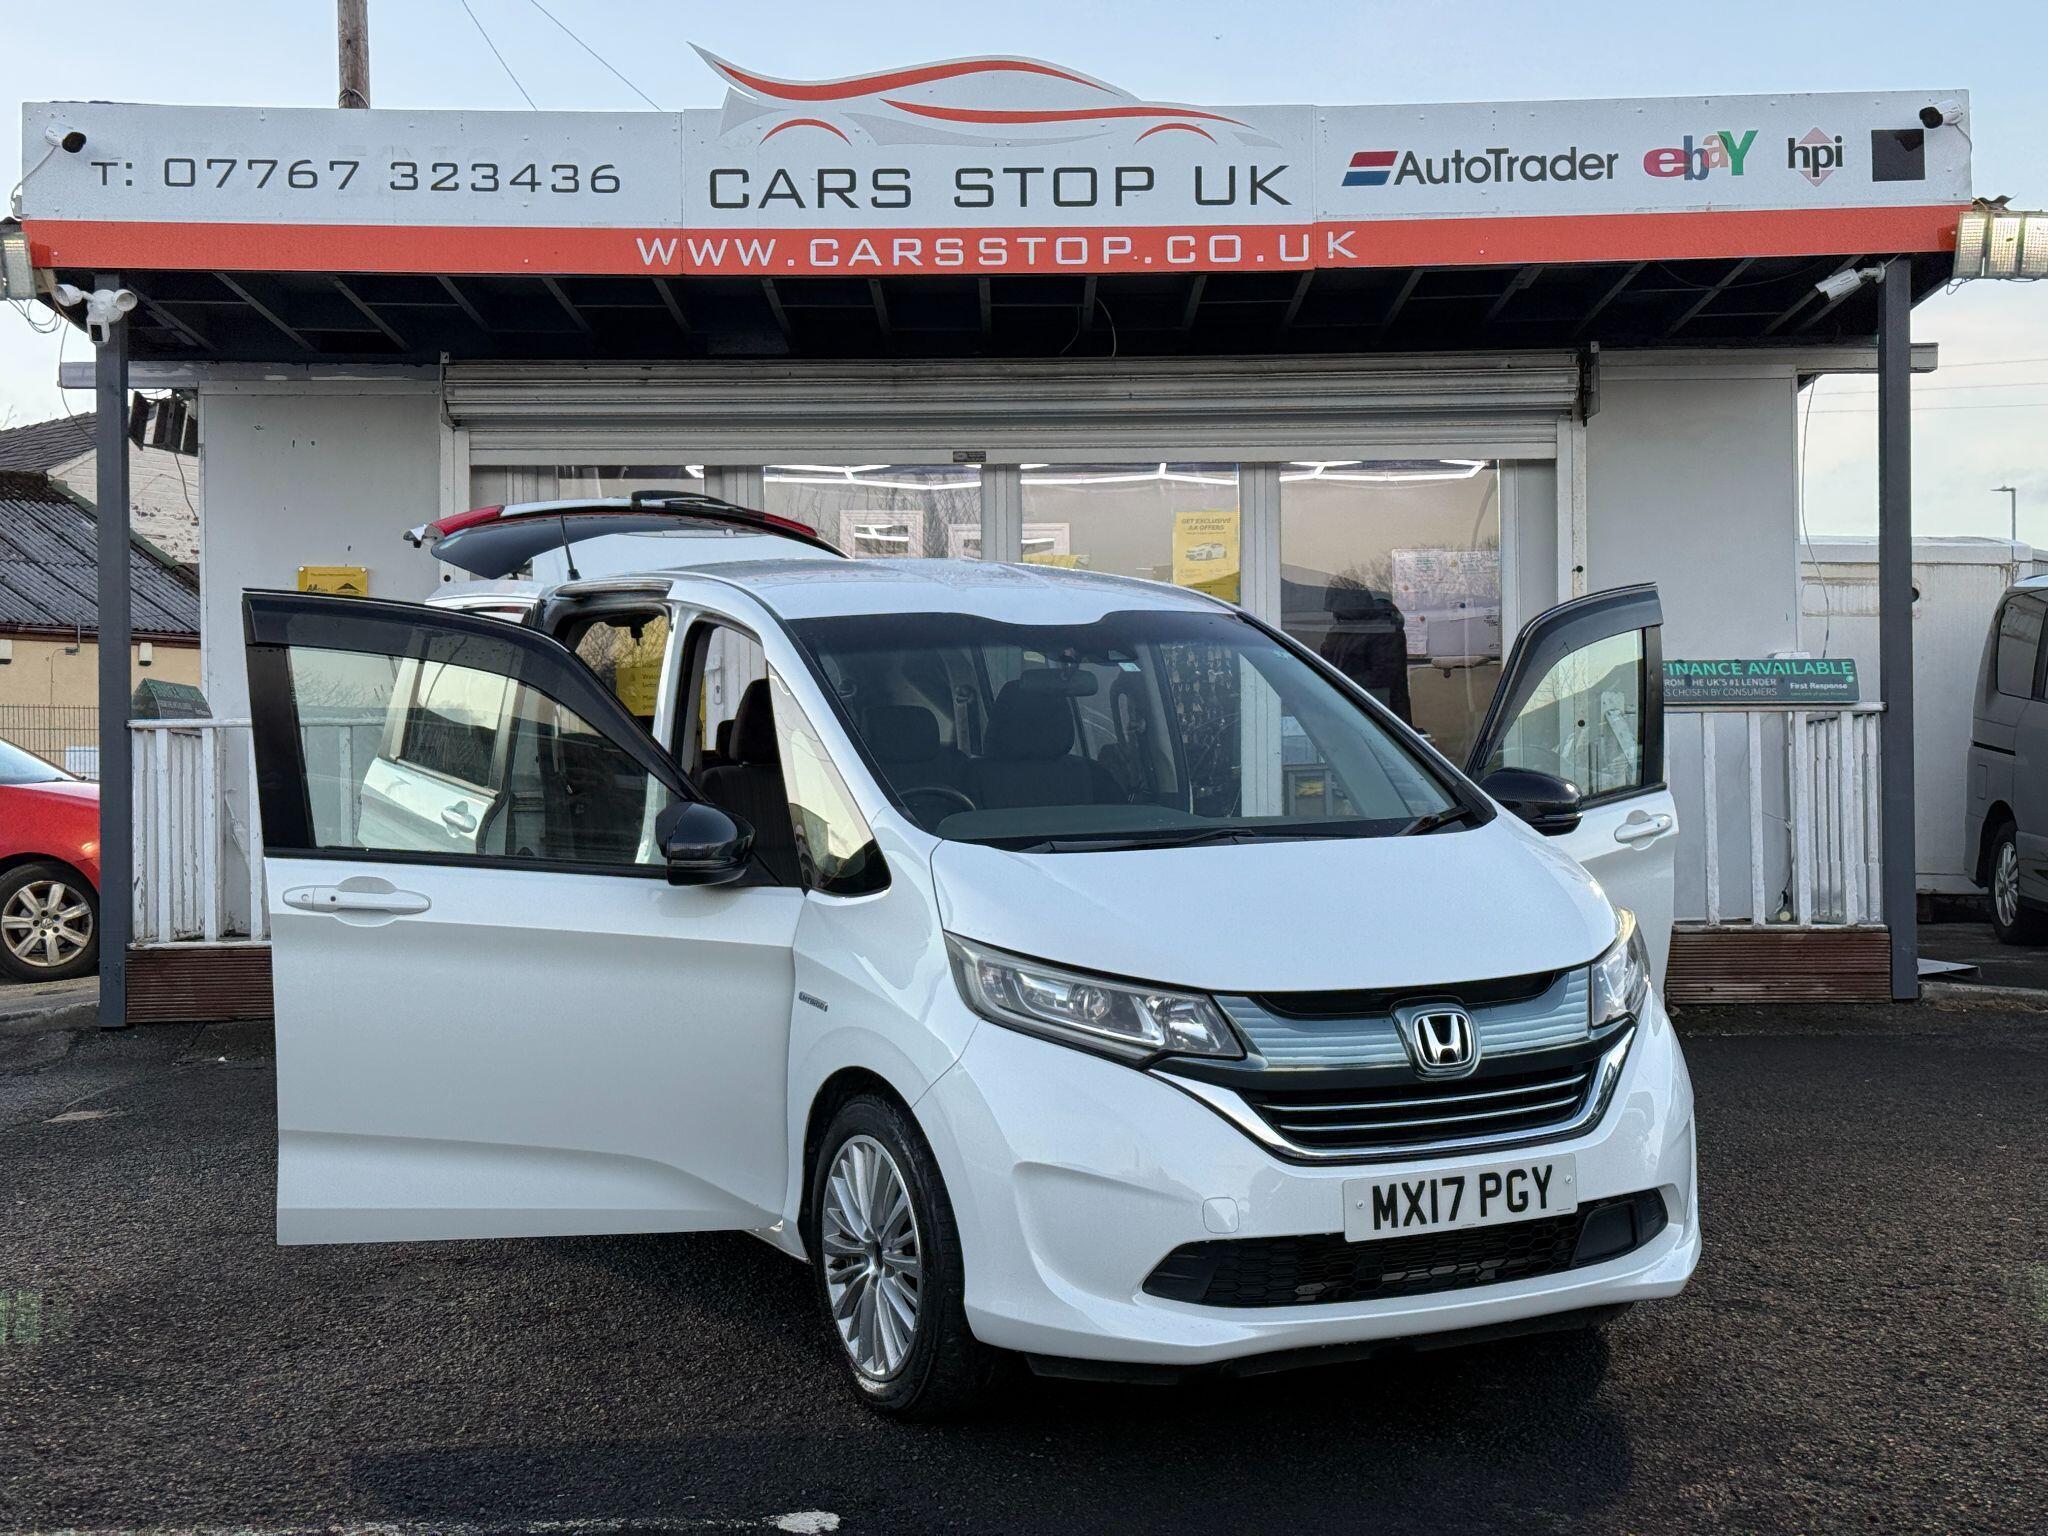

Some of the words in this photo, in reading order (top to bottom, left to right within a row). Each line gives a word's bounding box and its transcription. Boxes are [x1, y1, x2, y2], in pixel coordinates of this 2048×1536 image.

[1393, 146, 1619, 186] AutoTrader
[1787, 135, 1844, 178] hpi
[164, 157, 360, 190] 07767
[389, 161, 621, 194] 323436
[709, 168, 912, 209] CARS
[953, 165, 1155, 208] STOP
[1194, 164, 1293, 206] UK
[635, 230, 1359, 267] WWW.CARSSTOP.CO.UK
[1663, 679, 1685, 687] ROM
[1741, 678, 1777, 687] LENDER
[1748, 661, 1854, 676] AVAILABLE
[1672, 688, 1709, 697] CHOSEN
[1710, 688, 1721, 697] BY
[1723, 687, 1778, 697] CONSUMERS
[1371, 1175, 1466, 1231] MX17
[1478, 1164, 1553, 1218] PGY
